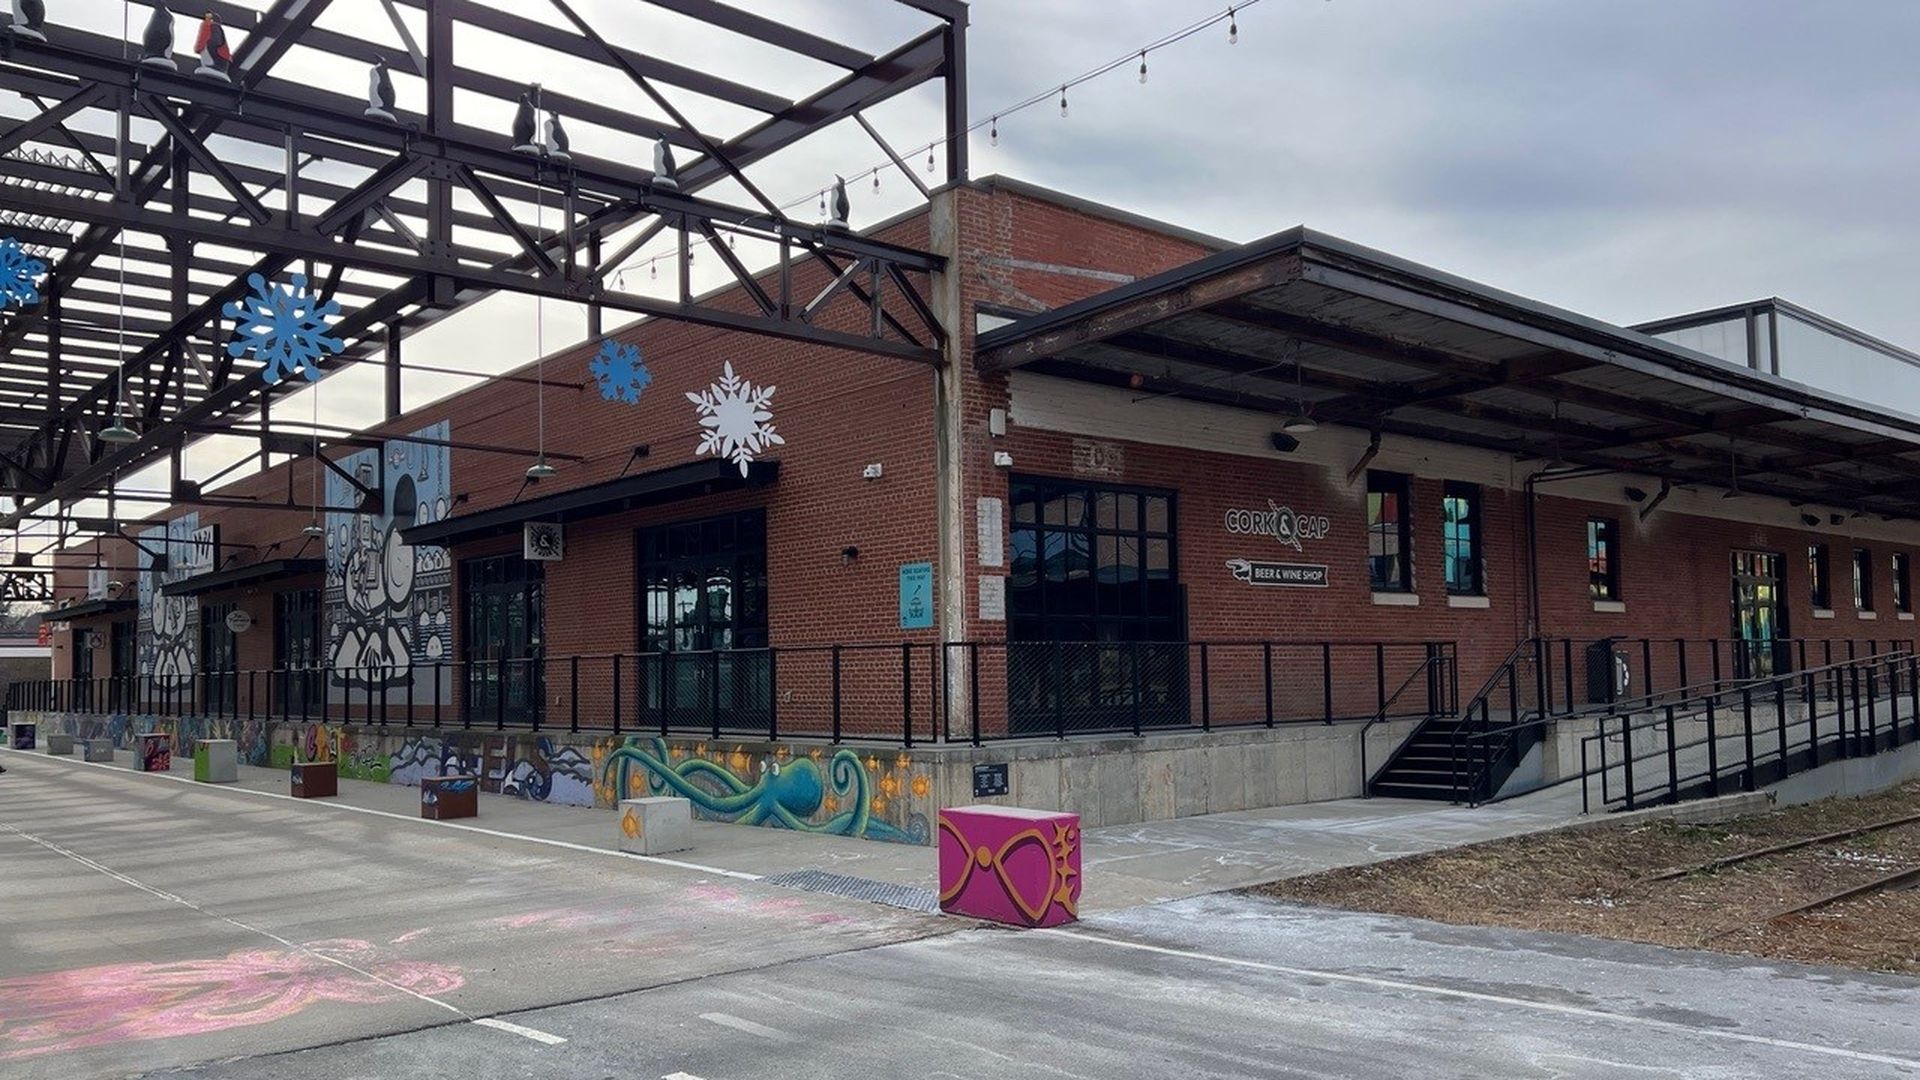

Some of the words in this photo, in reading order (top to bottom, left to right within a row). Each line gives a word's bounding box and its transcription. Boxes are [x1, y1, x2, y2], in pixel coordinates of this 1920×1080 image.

[1225, 508, 1275, 535] CORK
[1296, 515, 1329, 539] CAP
[1254, 568, 1275, 579] BEER
[1275, 569, 1282, 579] &
[1282, 569, 1302, 580] WINE
[1302, 570, 1323, 581] SHOP
